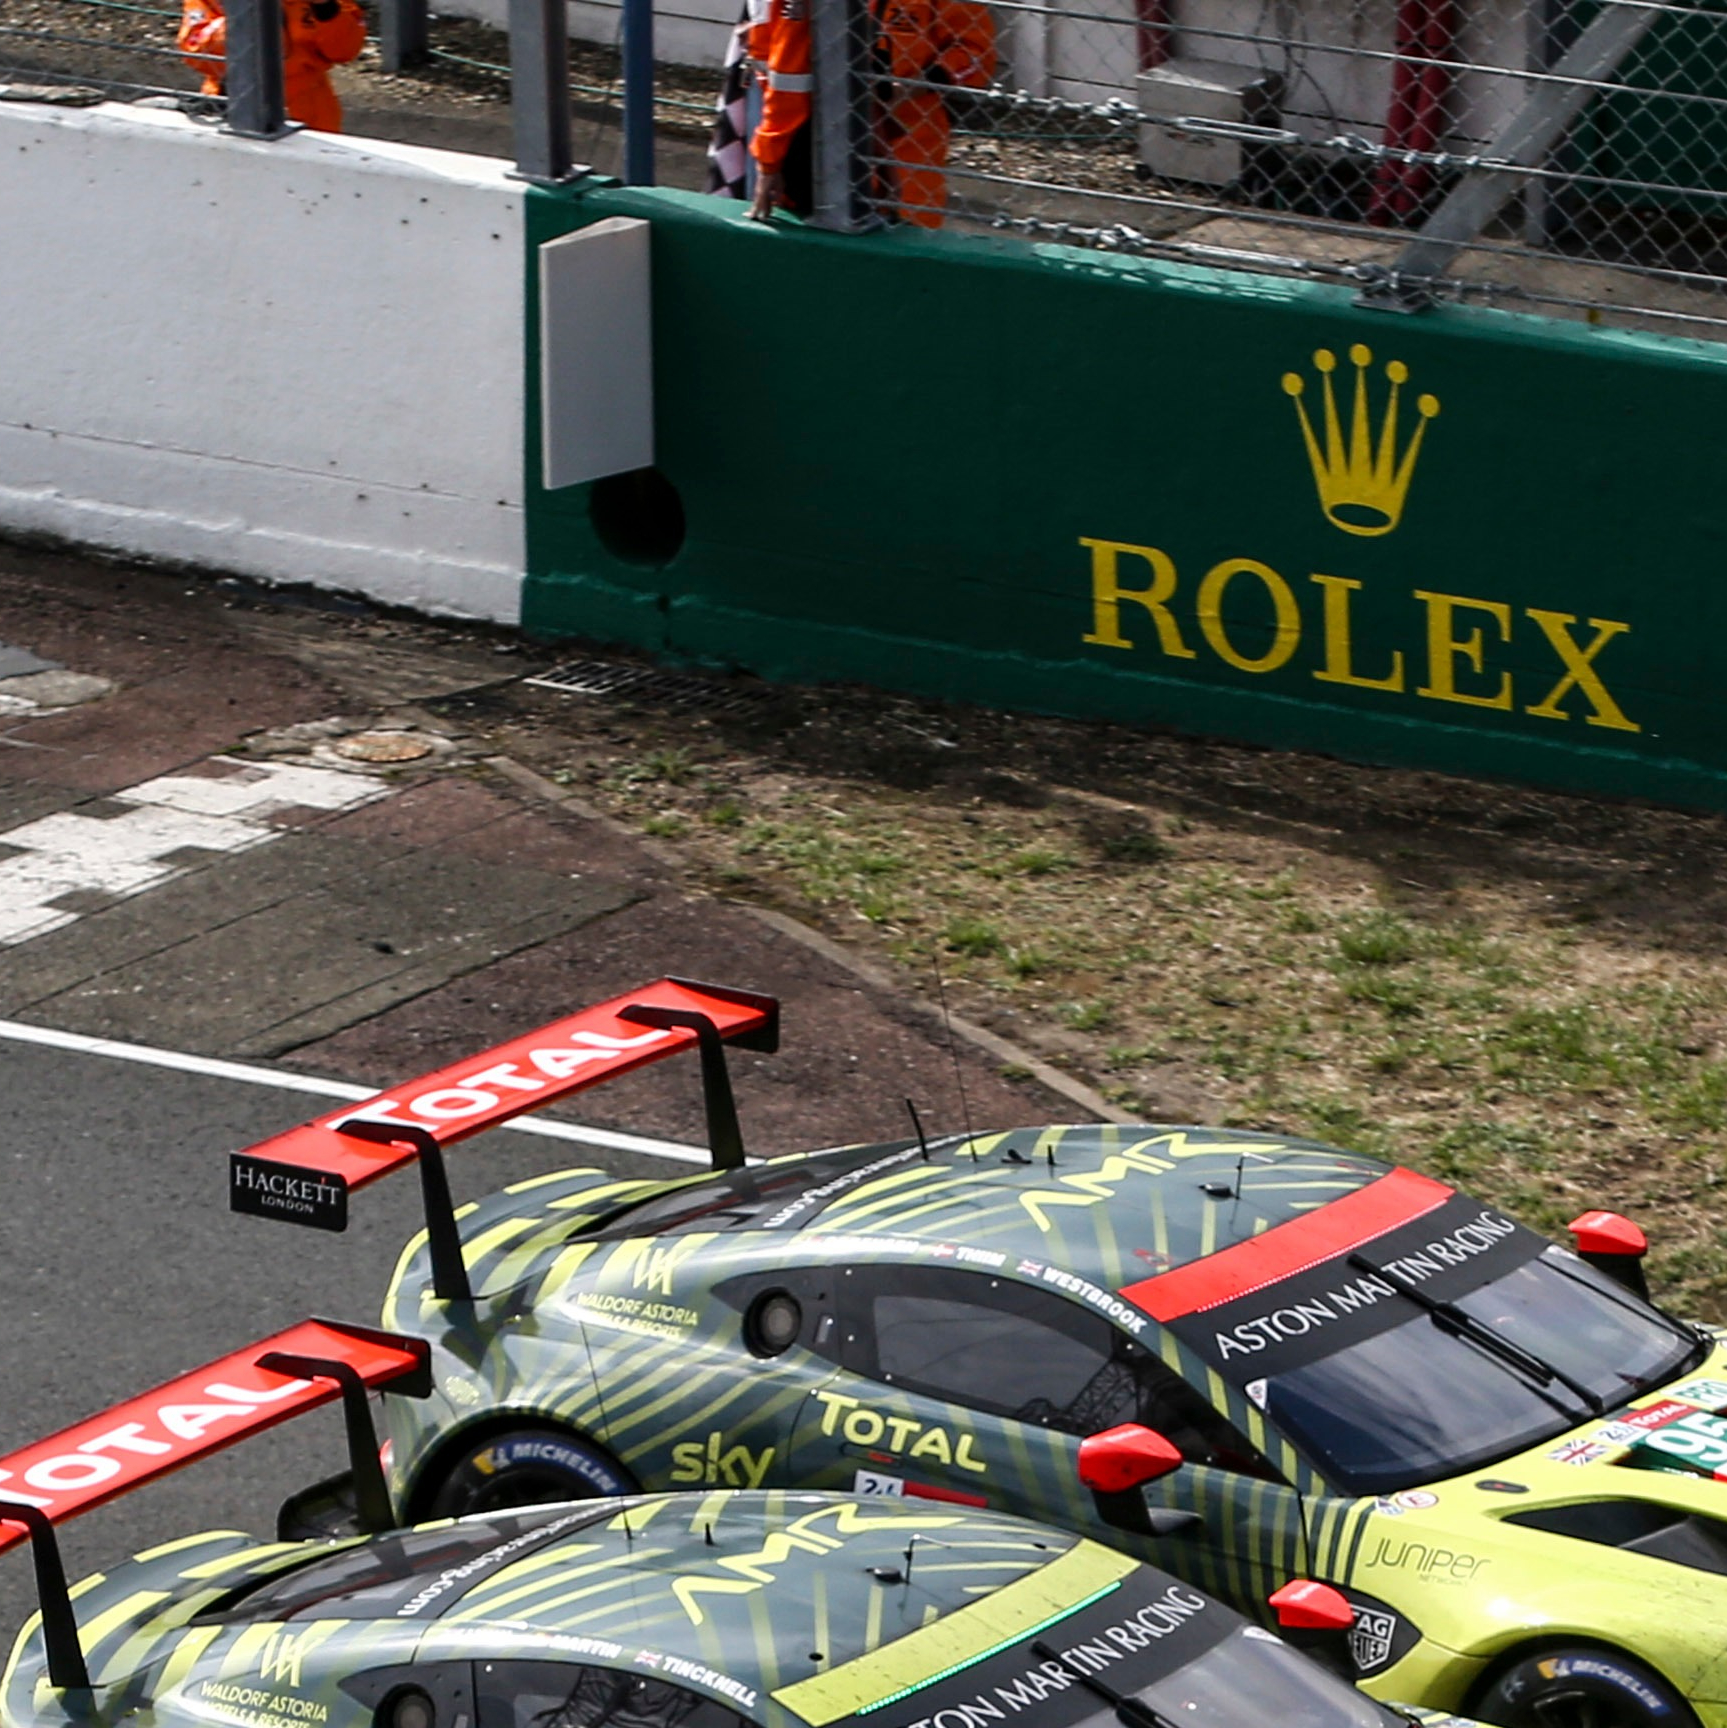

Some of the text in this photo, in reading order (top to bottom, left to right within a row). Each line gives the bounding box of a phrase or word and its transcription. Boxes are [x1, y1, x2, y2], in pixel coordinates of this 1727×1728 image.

[1078, 536, 1641, 732] ROLEX
[327, 1029, 671, 1132] TOTAL
[235, 1164, 341, 1206] HACKETT
[261, 1194, 315, 1214] LONDON
[578, 1292, 644, 1314] WALDORF
[639, 1301, 699, 1327] ASTORIA
[1041, 1267, 1148, 1335] WESTBROOK
[1215, 1298, 1339, 1360] ASTON
[1426, 1211, 1516, 1265] RACING
[817, 1390, 987, 1474] TOTAL
[1627, 1402, 1689, 1427] TOTAL
[511, 1442, 618, 1493] MICHELIN
[669, 1432, 776, 1490] sky
[993, 1637, 1125, 1712] MARTIN
[1104, 1585, 1207, 1653] RACING
[201, 1680, 328, 1723] WALDORF ASTORIA
[662, 1656, 756, 1707] TINCKNELL
[1571, 1659, 1663, 1709] MICHELIN
